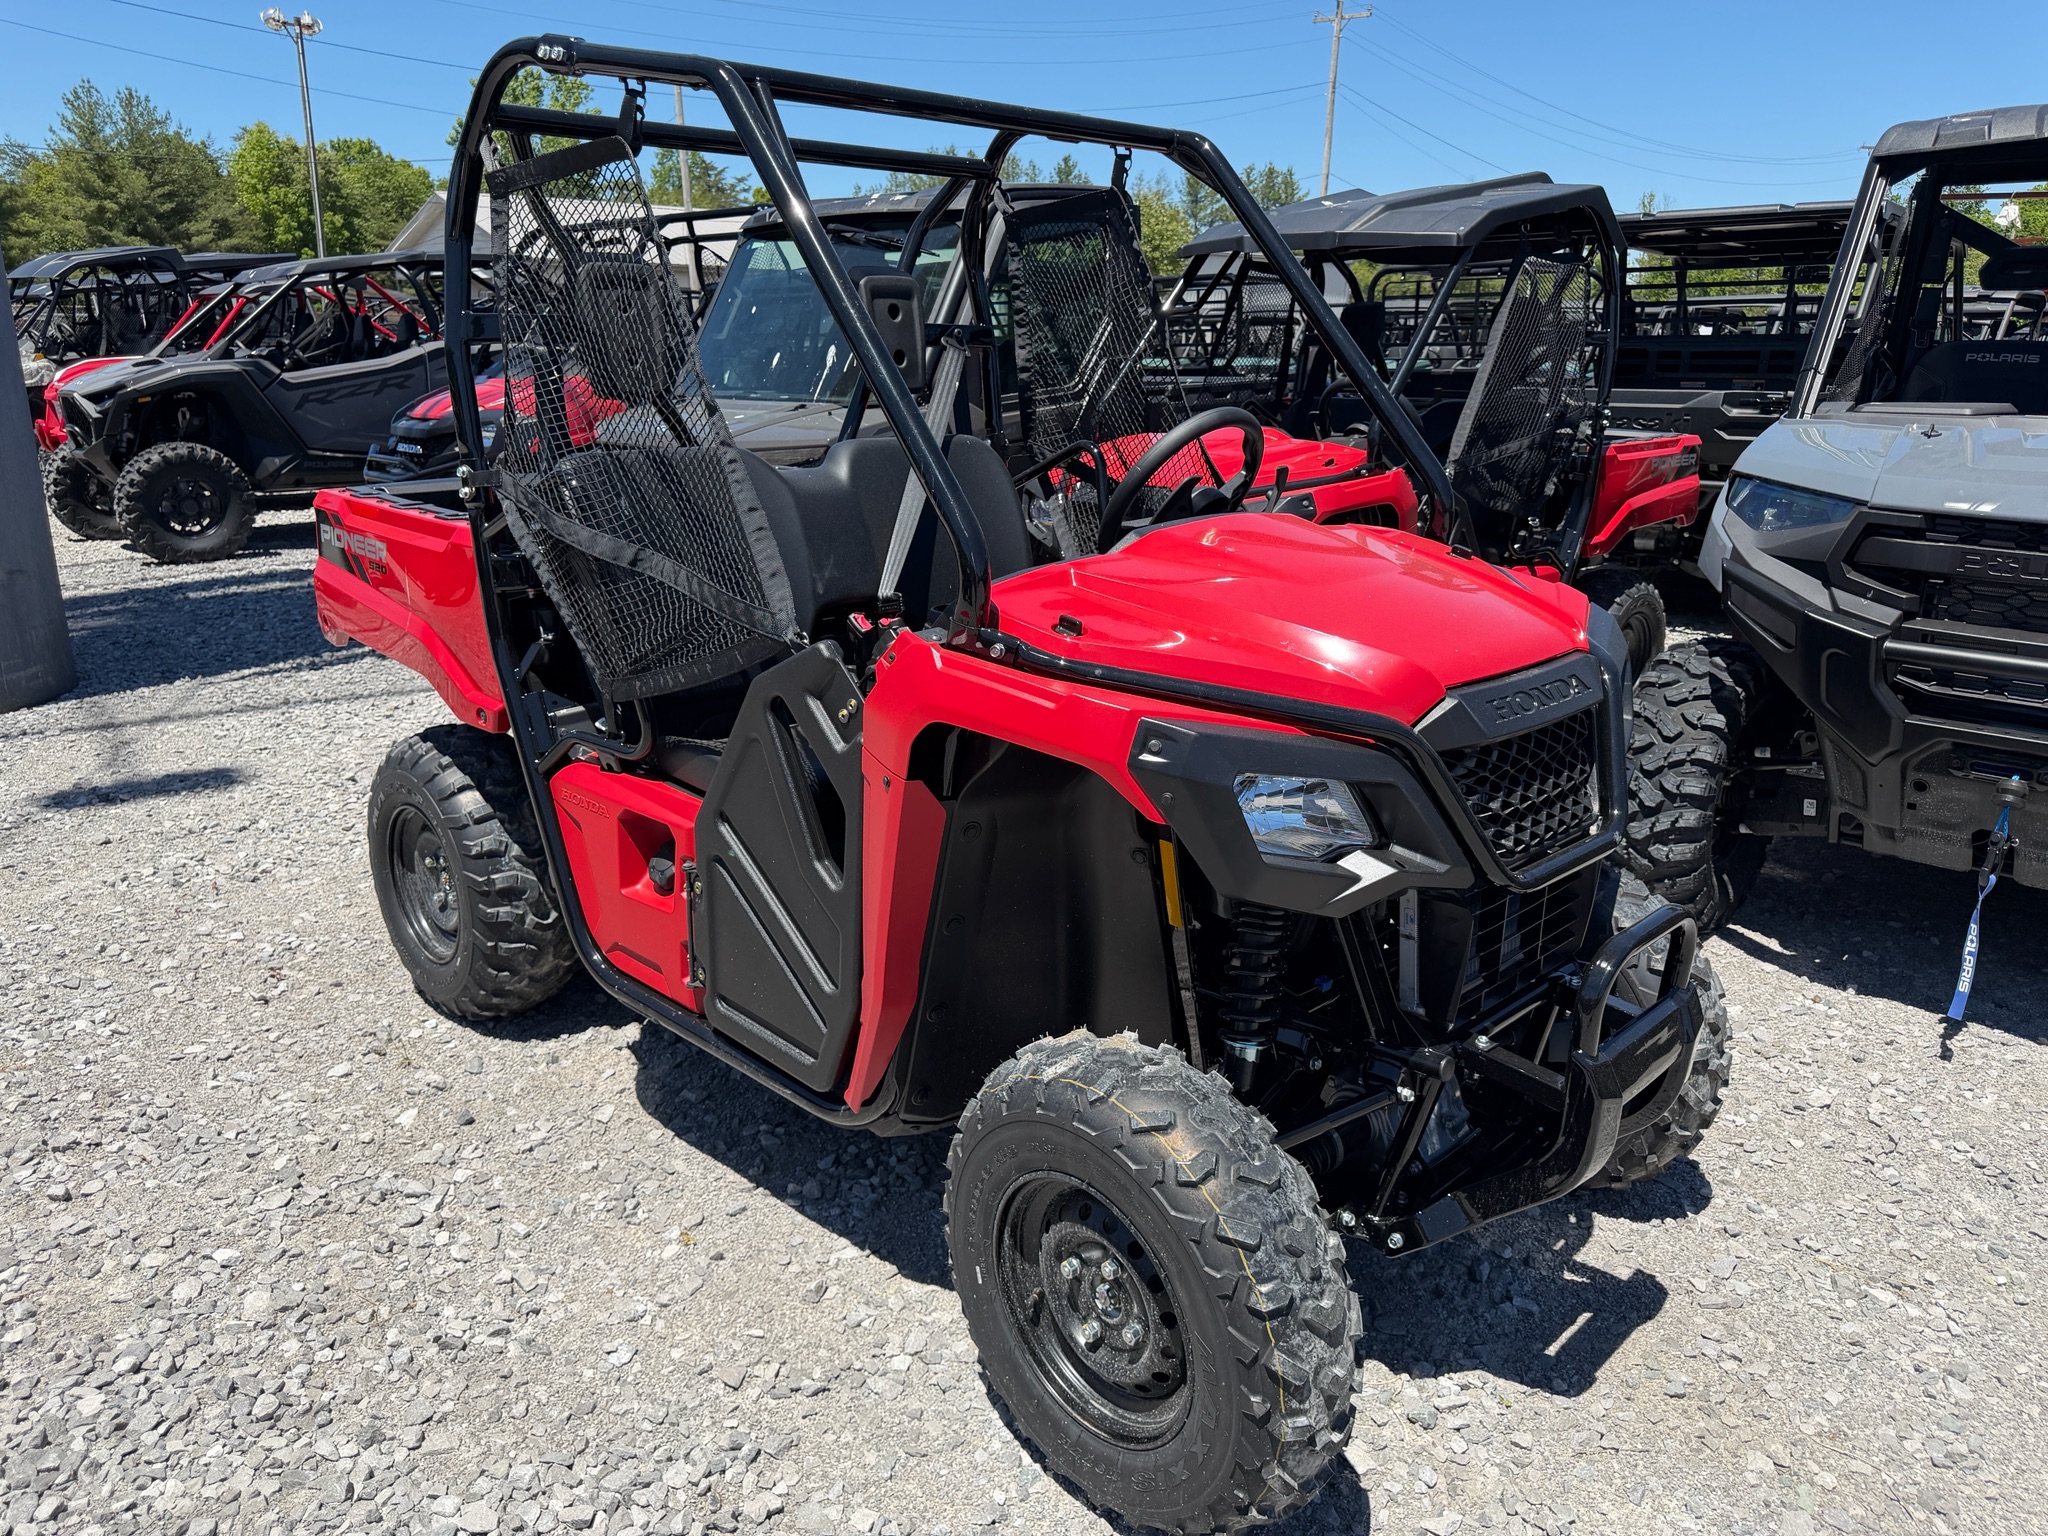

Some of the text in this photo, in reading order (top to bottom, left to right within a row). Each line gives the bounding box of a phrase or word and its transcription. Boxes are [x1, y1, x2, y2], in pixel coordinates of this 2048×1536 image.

[1965, 352, 2041, 364] POLARIS
[292, 373, 415, 413] RZR
[303, 459, 355, 469] POLARIS
[1651, 453, 1698, 471] PIONEER
[320, 523, 387, 563] PIONEER
[368, 560, 388, 576] 520
[1956, 551, 2048, 581] POL
[1485, 673, 1593, 724] HONDA
[560, 787, 610, 819] HONDA
[1957, 923, 1978, 993] POLARIS
[1130, 1330, 1219, 1492] MAXXIS
